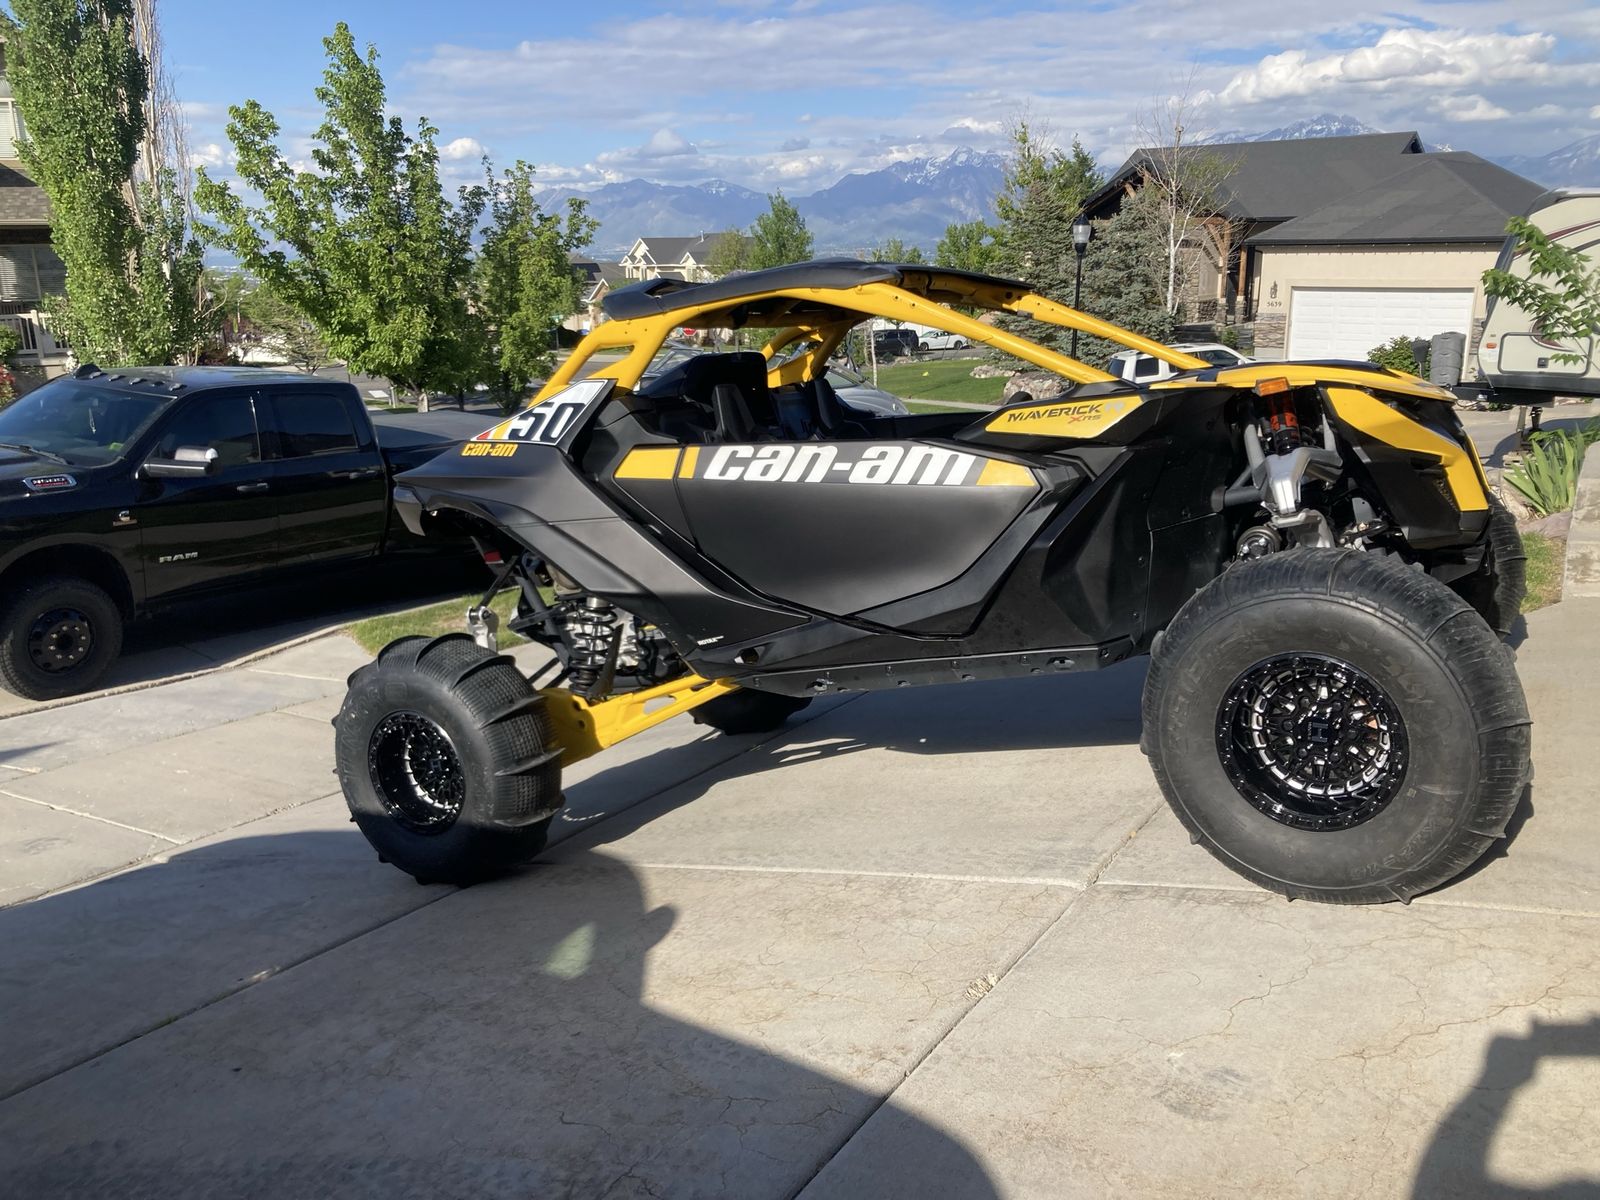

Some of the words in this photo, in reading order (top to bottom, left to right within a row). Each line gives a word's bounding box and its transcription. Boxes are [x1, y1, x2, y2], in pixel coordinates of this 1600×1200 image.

[508, 402, 587, 442] 50
[1008, 403, 1103, 423] MAVERICK
[461, 443, 518, 457] can-am
[703, 445, 976, 485] can-am
[159, 551, 198, 563] RAM
